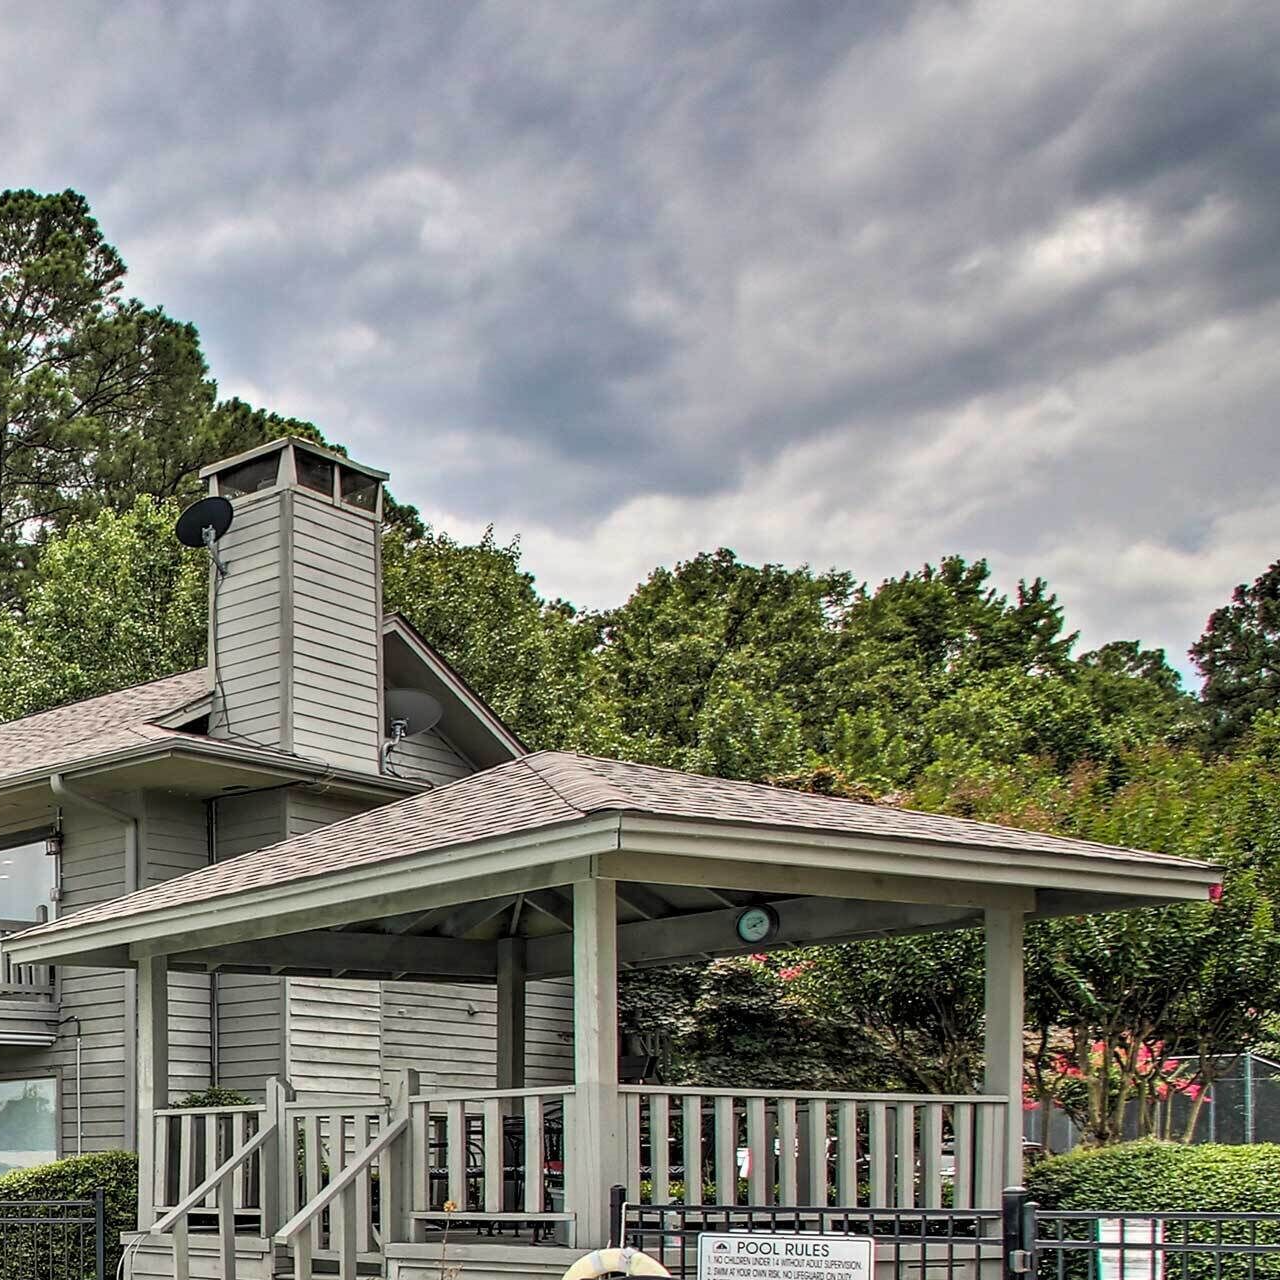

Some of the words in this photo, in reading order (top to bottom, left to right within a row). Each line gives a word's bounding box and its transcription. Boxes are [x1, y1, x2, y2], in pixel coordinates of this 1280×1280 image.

[737, 1241, 780, 1255] POOL
[785, 1243, 830, 1257] RULES
[713, 1255, 722, 1265] NO
[724, 1255, 751, 1266] CHILDREN
[752, 1257, 770, 1266] UNDER
[772, 1257, 780, 1266] 14
[781, 1258, 805, 1268] WITHOUT
[805, 1259, 823, 1268] ADULT
[713, 1267, 728, 1276] SWIM
[729, 1267, 736, 1276] AT
[736, 1268, 751, 1277] YOUR
[752, 1269, 767, 1278] OWN
[782, 1270, 792, 1280] NO
[793, 1271, 825, 1280] LIFEGUARD
[826, 1272, 836, 1280] ON
